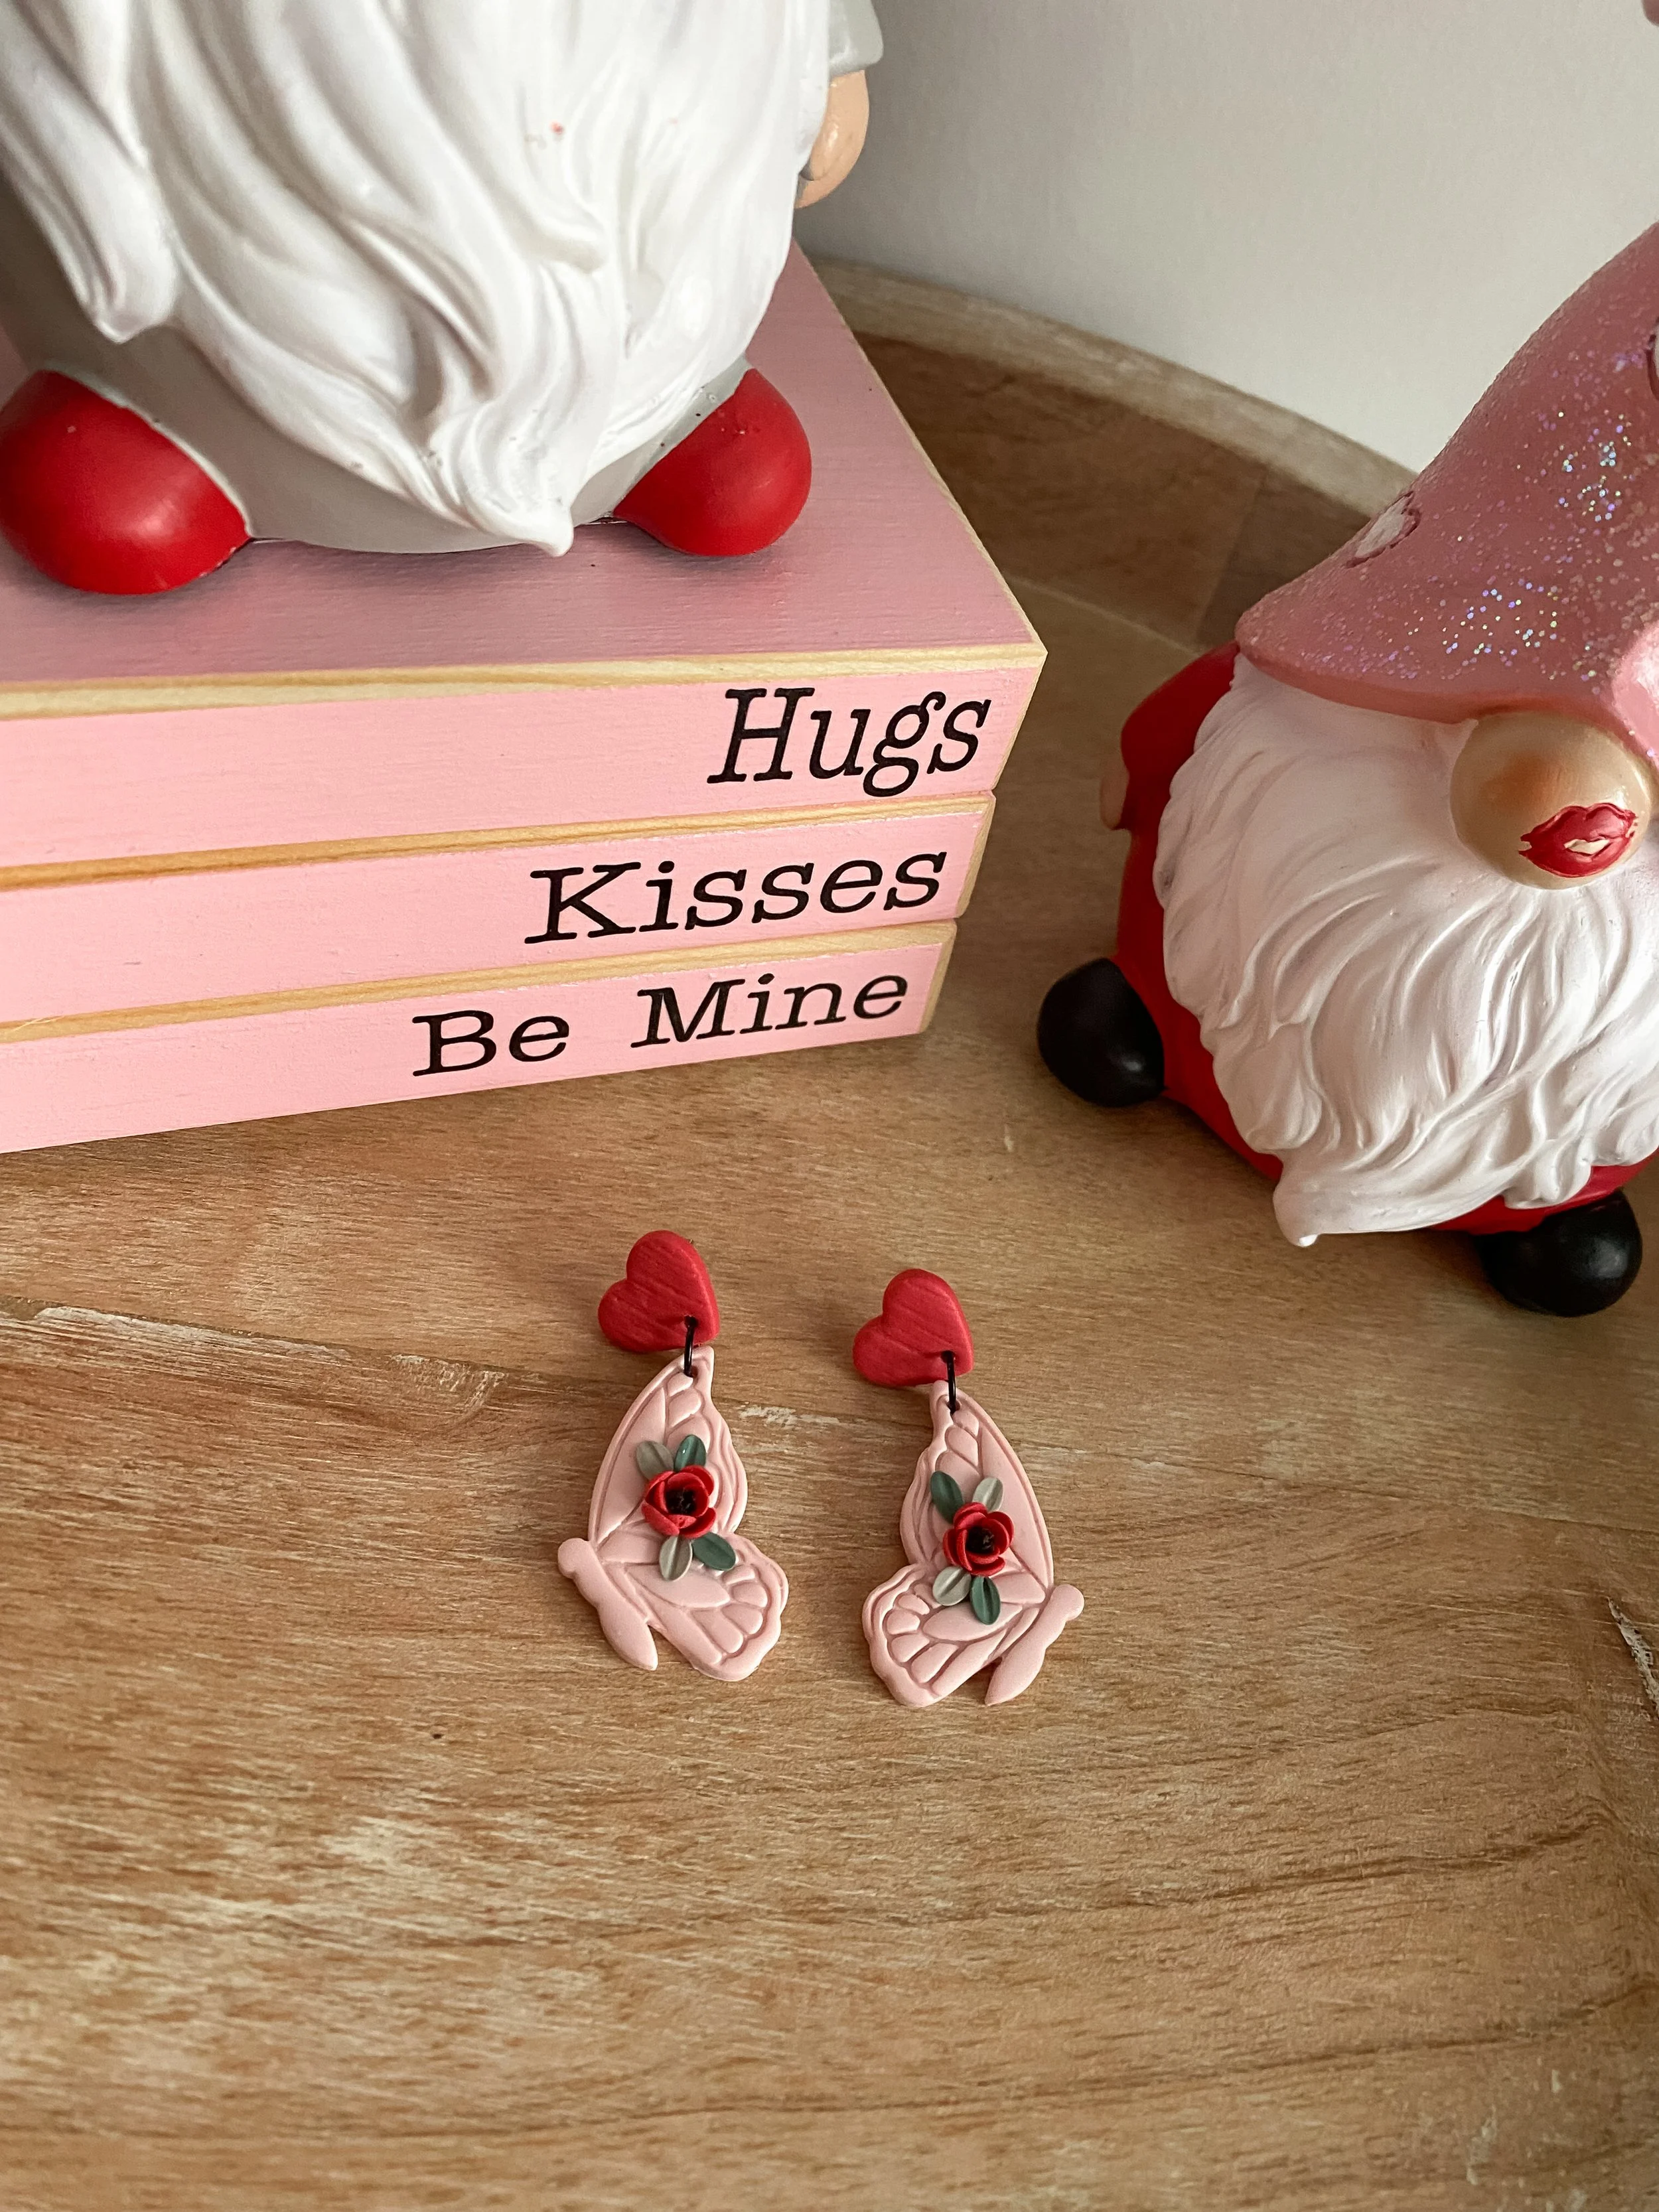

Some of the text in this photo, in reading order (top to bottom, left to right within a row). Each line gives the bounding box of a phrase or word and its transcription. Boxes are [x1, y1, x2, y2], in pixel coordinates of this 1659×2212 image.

[707, 688, 992, 798] Hugs
[524, 851, 947, 944] Kisses
[412, 973, 908, 1077] Be Mine
